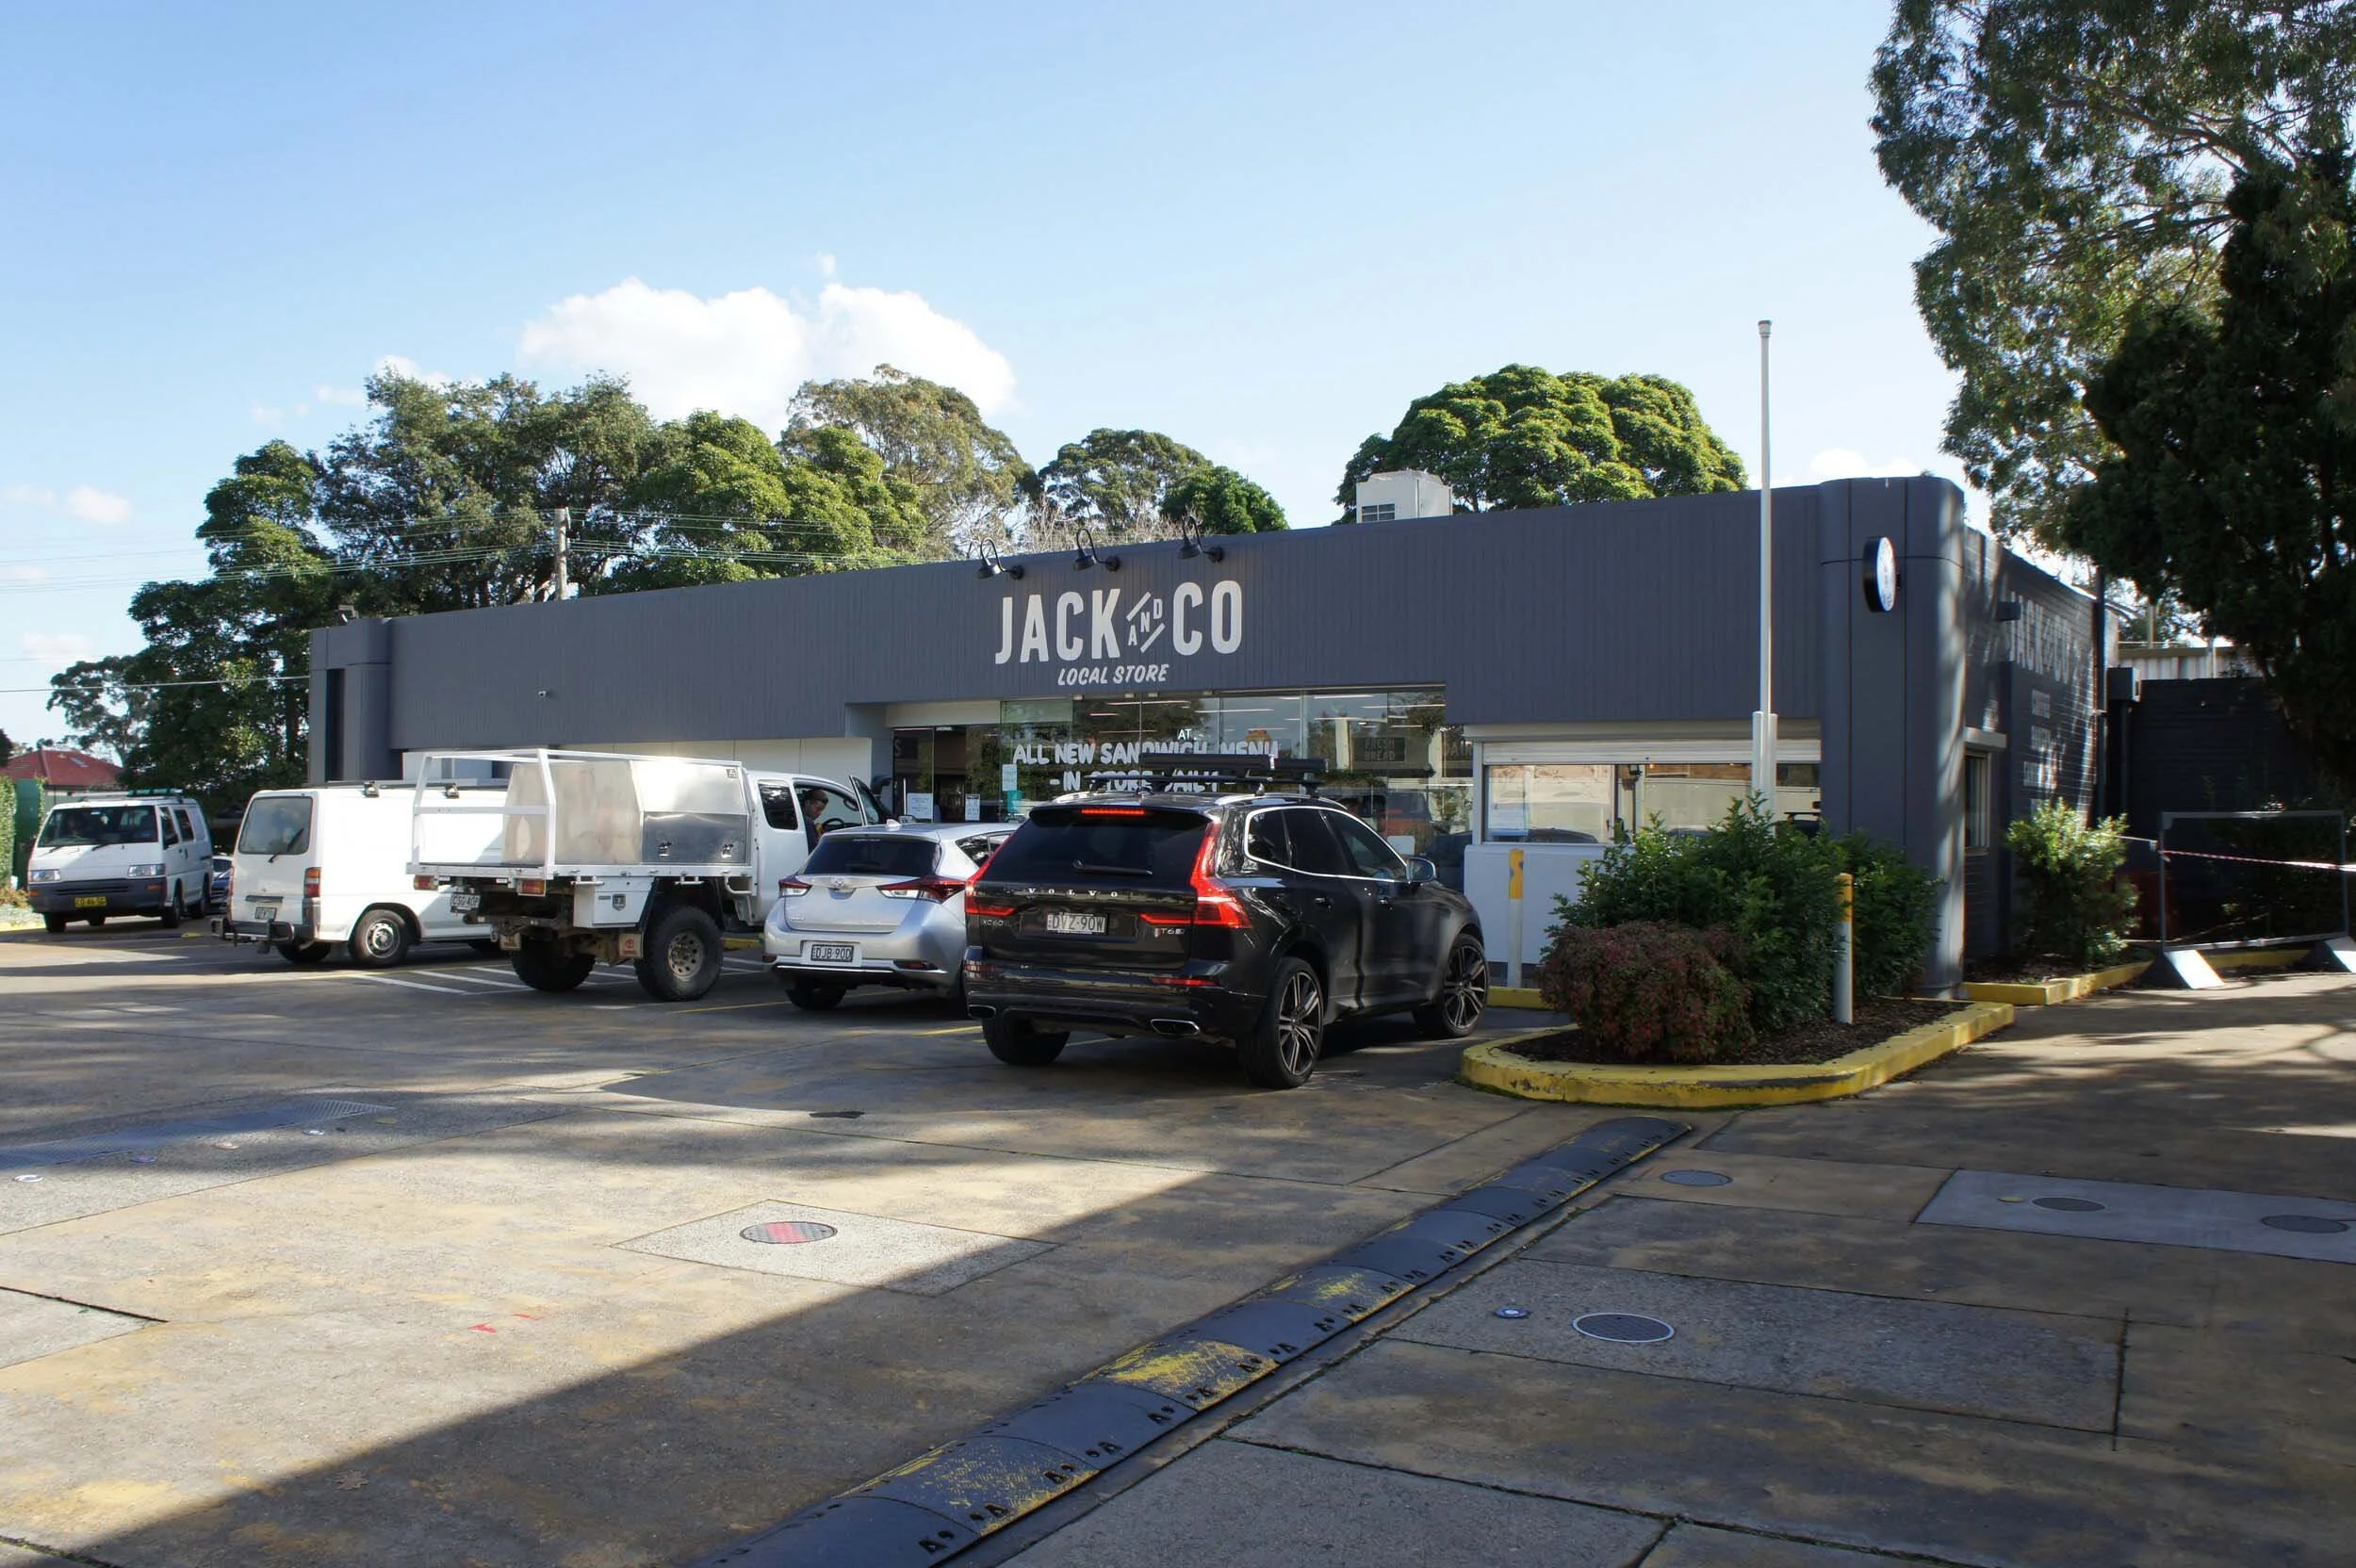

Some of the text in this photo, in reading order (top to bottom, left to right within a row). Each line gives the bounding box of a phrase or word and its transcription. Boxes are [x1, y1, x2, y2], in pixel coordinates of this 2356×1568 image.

[995, 580, 1242, 664] JACK AND CO
[1057, 663, 1170, 686] LOCAL STORE
[1177, 728, 1192, 740] AT
[1012, 743, 1050, 765] ALL
[1055, 743, 1096, 765] NEW
[1063, 771, 1081, 792] IN
[1028, 888, 1118, 897] VOLVO
